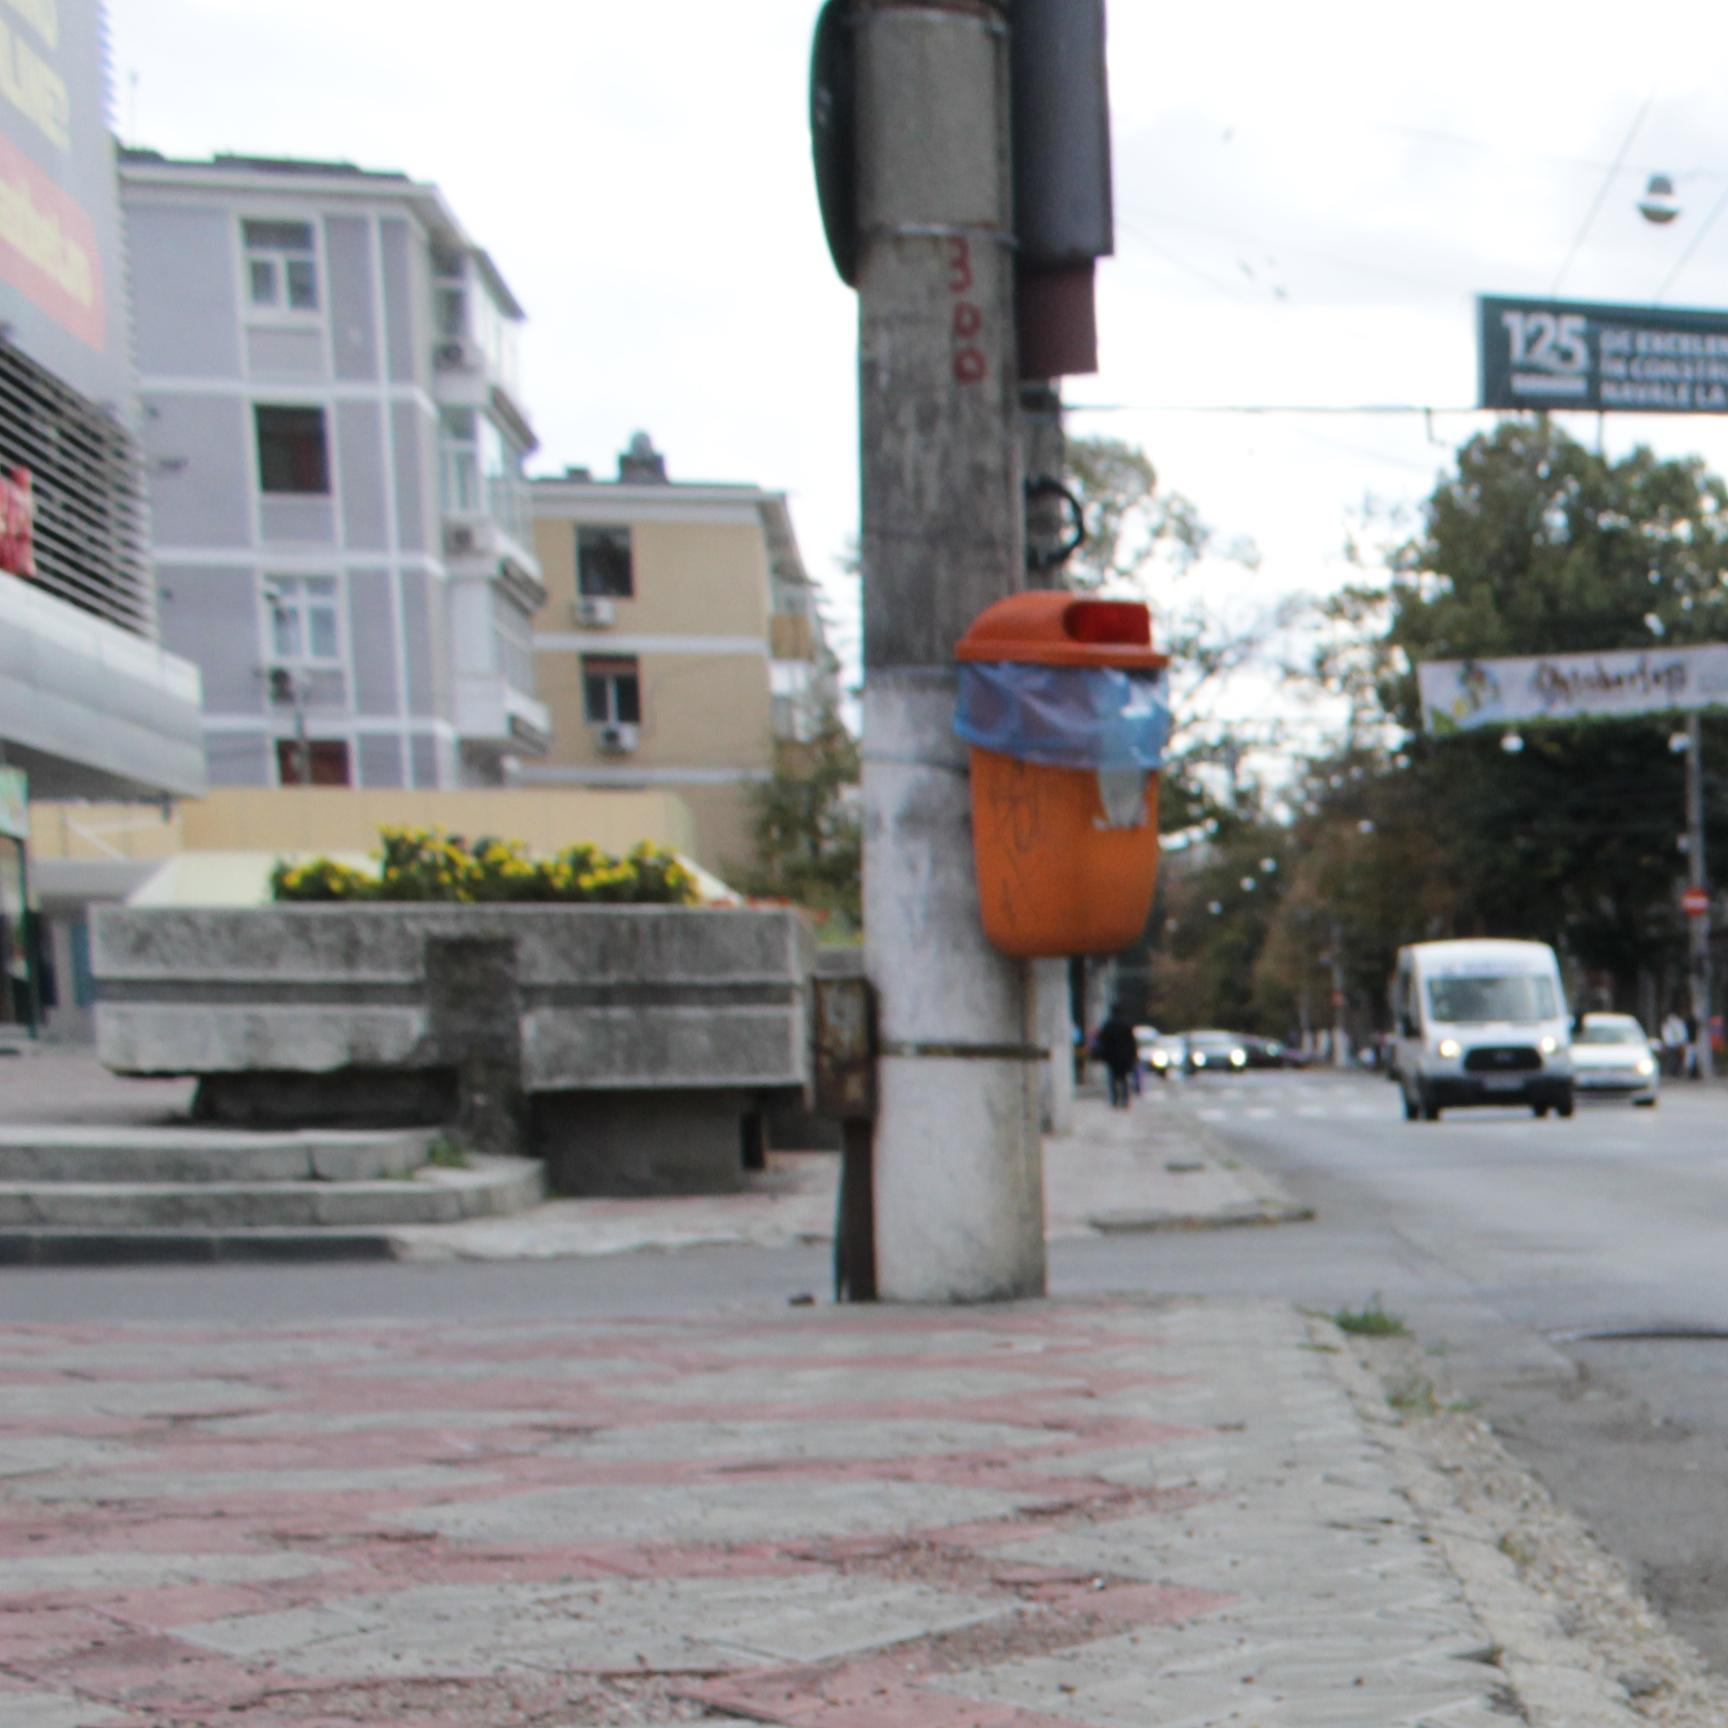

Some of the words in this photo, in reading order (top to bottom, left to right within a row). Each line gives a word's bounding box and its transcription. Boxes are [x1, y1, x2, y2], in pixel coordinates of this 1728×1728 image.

[1501, 310, 1590, 375] 125
[1600, 329, 1632, 355] DE
[1600, 381, 1692, 408] NAVALE
[1694, 384, 1726, 409] LA
